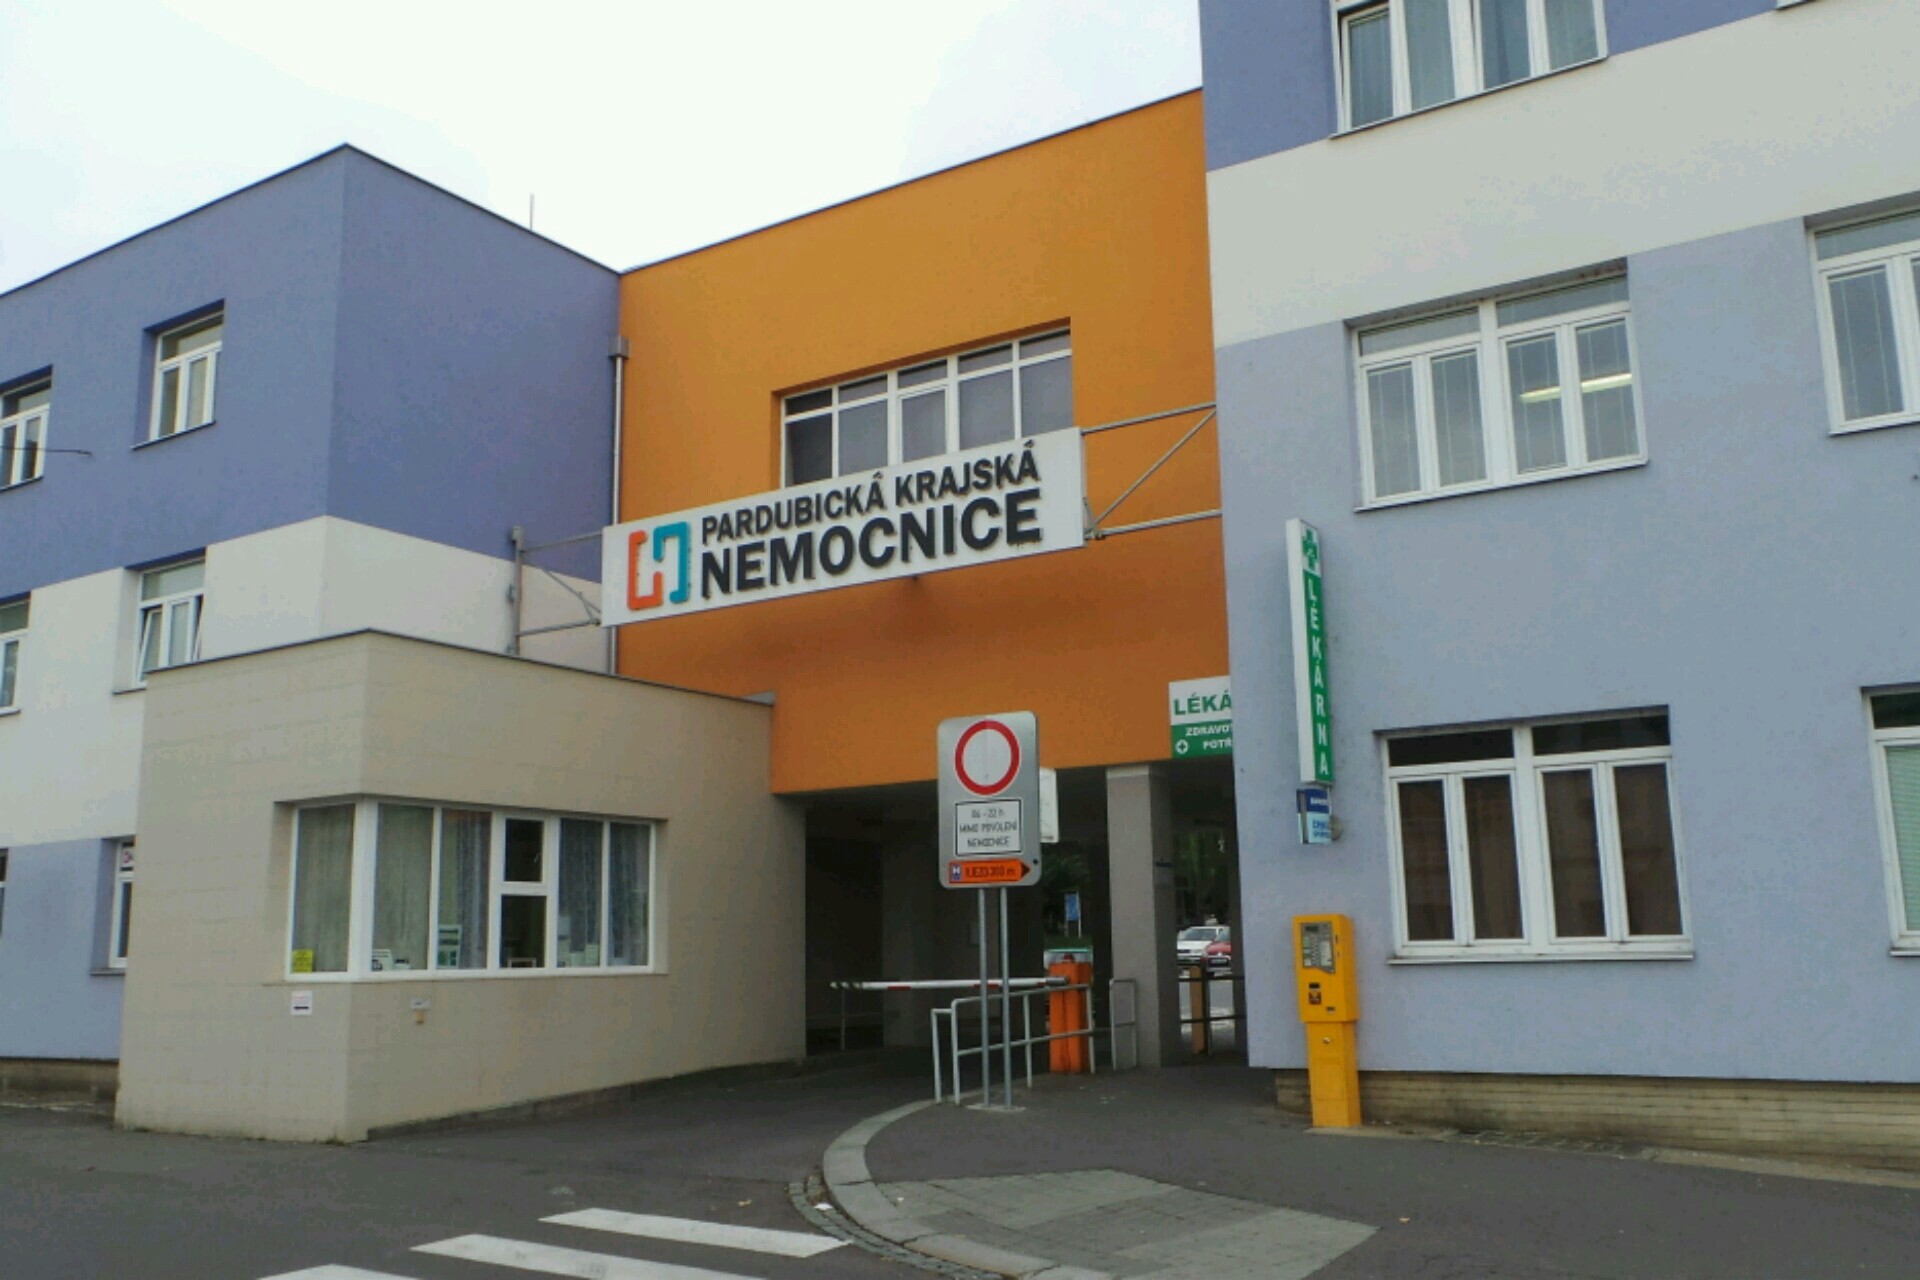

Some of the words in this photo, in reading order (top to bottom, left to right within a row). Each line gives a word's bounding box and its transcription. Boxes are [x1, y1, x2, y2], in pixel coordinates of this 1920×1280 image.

[702, 471, 886, 546] PARDUBICKÁ
[895, 439, 1041, 506] KRAJSKÁ
[702, 487, 1042, 600] NEMOCNICE
[1174, 689, 1231, 715] LÉKÁ
[1308, 578, 1329, 775] LÉKÁRNA
